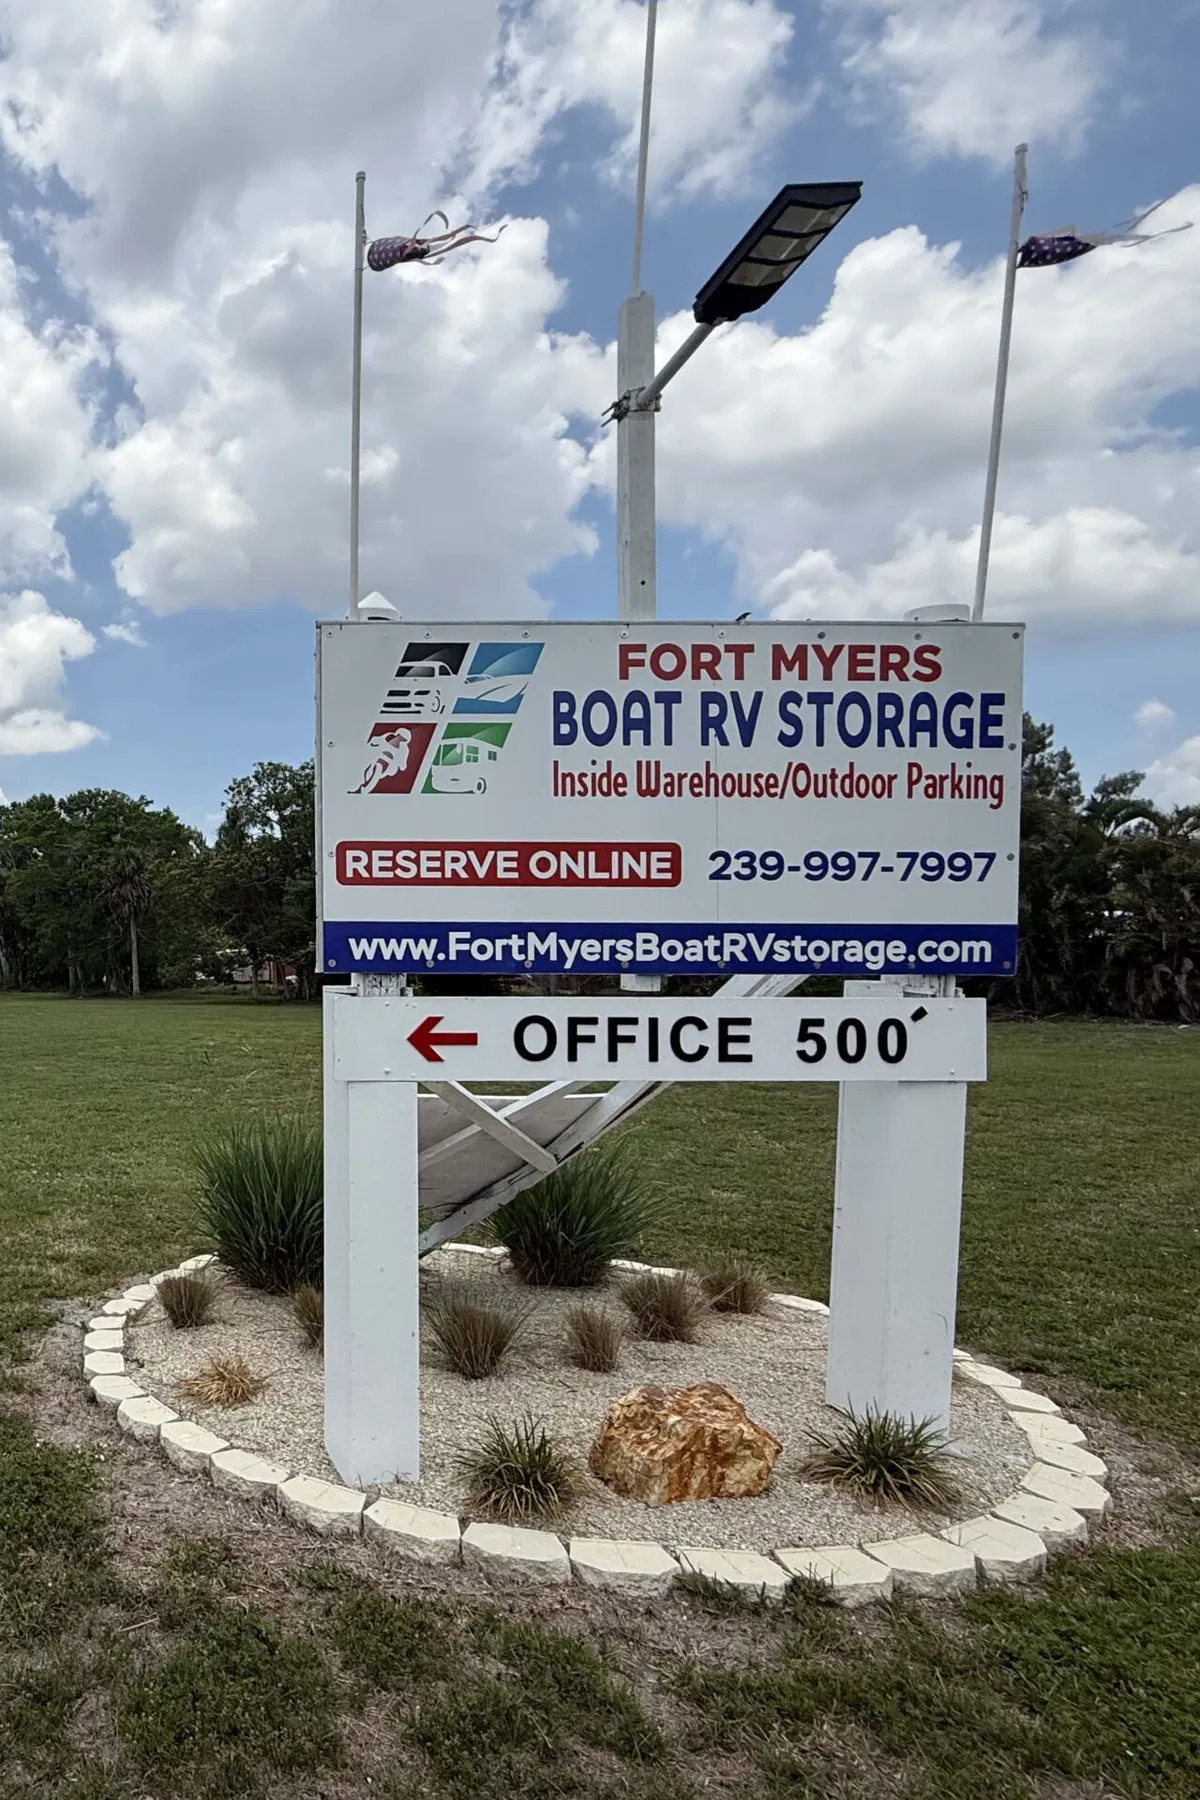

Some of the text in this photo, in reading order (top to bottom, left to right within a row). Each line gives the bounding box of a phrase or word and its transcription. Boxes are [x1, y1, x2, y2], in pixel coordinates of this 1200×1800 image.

[618, 643, 942, 682] FORT MYERS
[553, 690, 1005, 749] BOAT RV STORAGE
[553, 760, 1004, 810] Inside Warehouse/Outdoor Parking
[345, 849, 673, 880] RESERVE ONLINE
[708, 850, 997, 882] 239-997-7997
[348, 931, 992, 971] www.FortMyersBoatRVstorage.com
[513, 1014, 753, 1063] OFFICE
